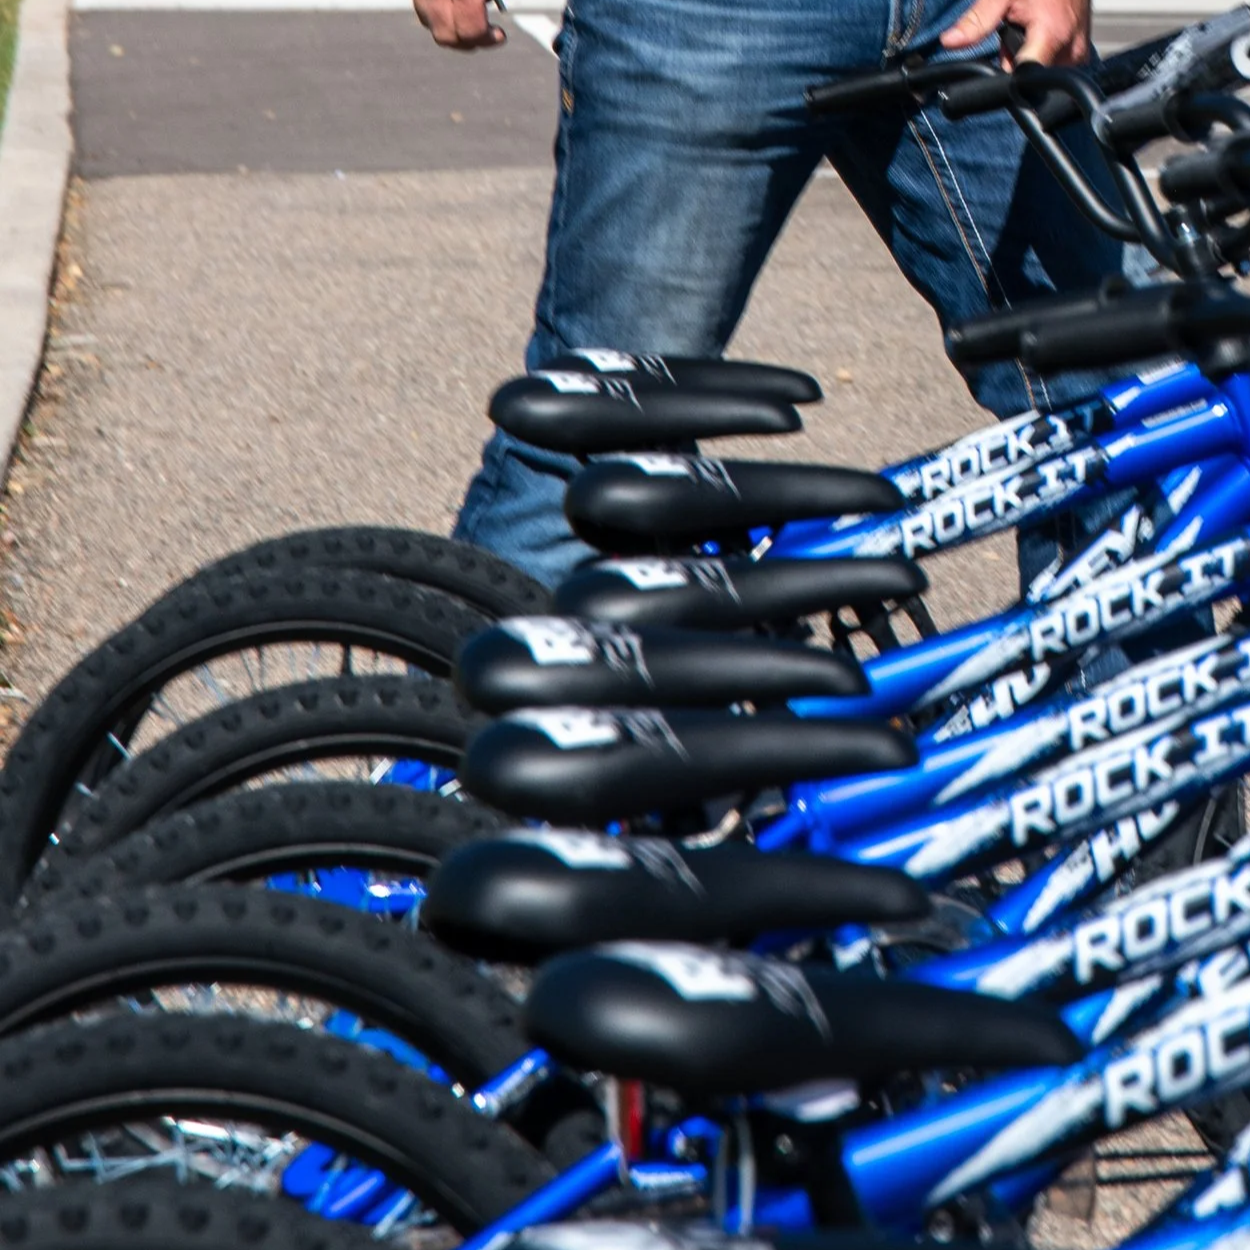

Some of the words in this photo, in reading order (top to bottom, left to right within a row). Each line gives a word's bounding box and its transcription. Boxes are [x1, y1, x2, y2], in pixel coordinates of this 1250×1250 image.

[901, 476, 1026, 559] ROCK
[1037, 447, 1098, 496] IT
[920, 423, 1036, 500] ROCK
[1030, 569, 1166, 662] ROCK
[1180, 537, 1245, 592] IT
[1067, 652, 1220, 749] ROCK
[1009, 735, 1177, 846] ROCK
